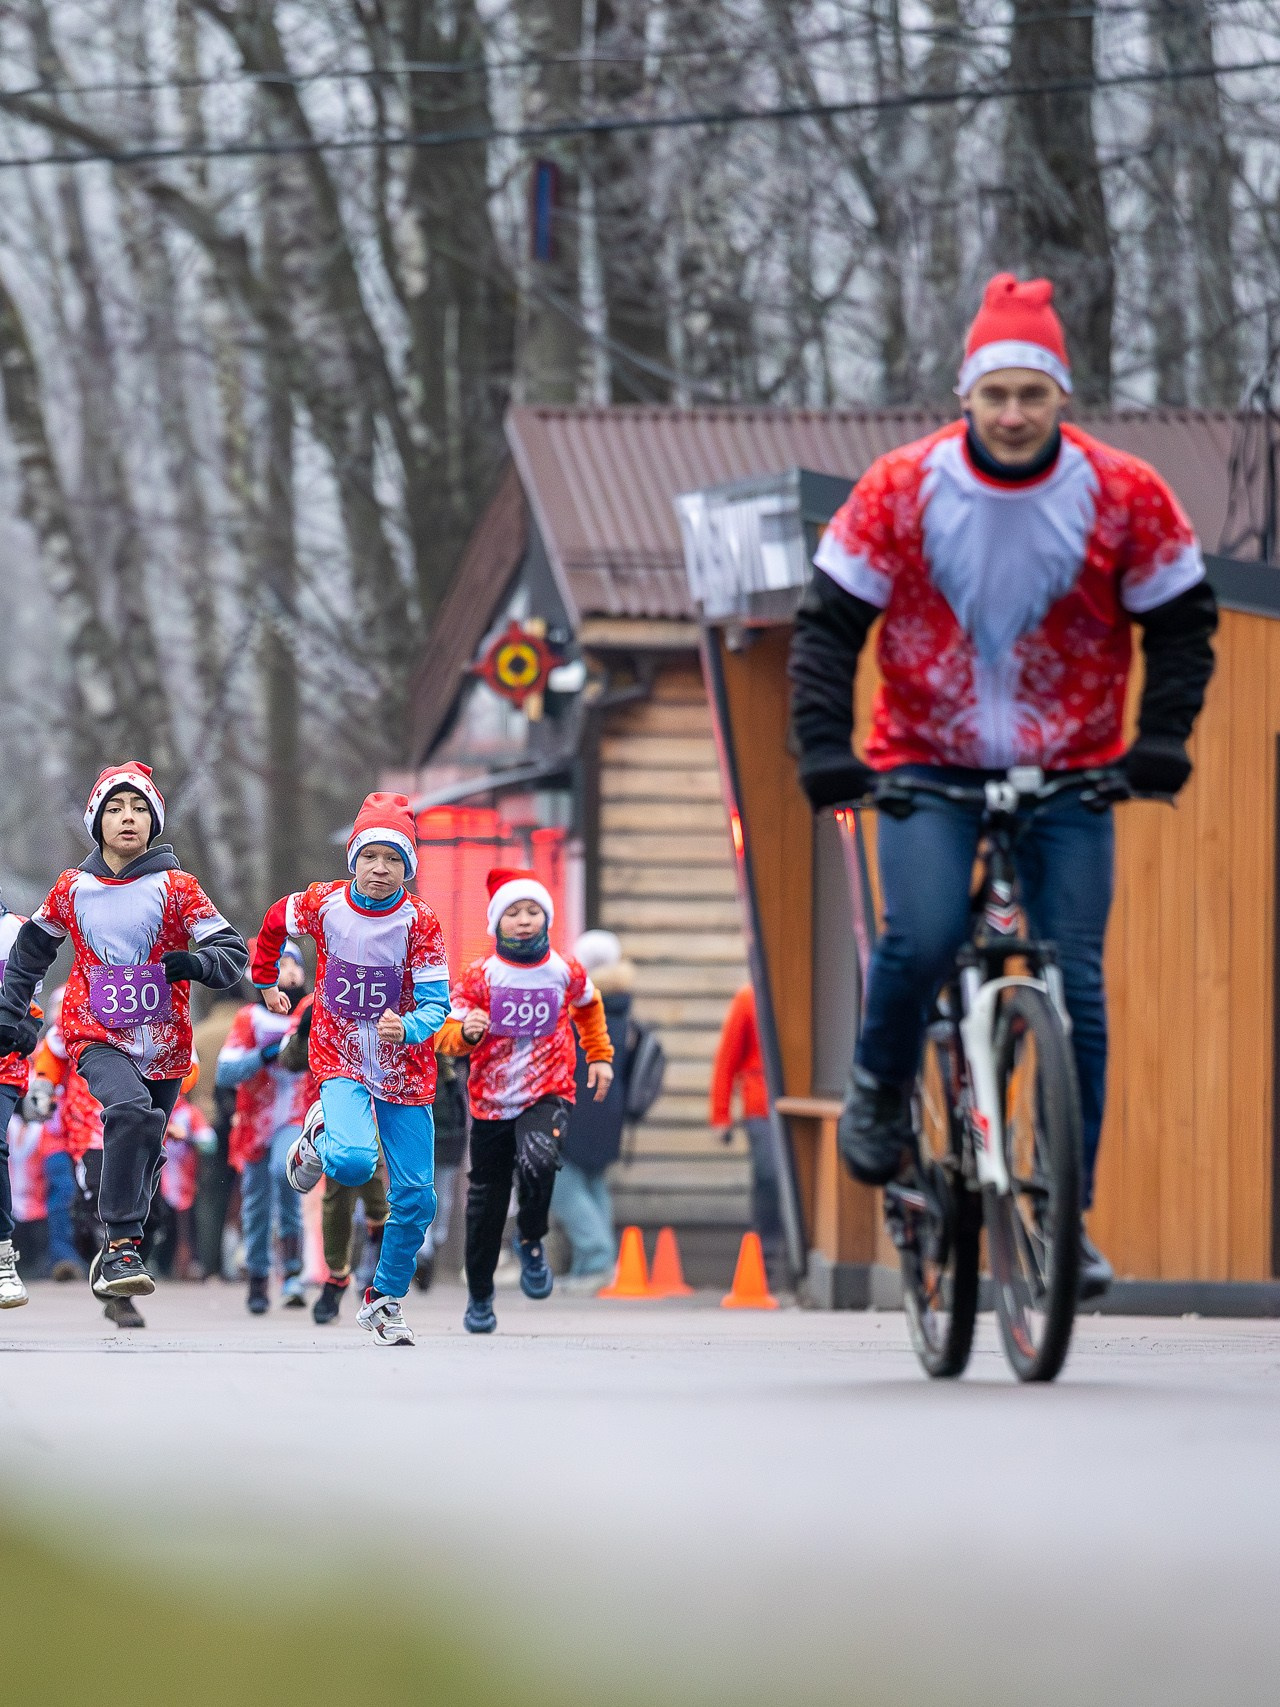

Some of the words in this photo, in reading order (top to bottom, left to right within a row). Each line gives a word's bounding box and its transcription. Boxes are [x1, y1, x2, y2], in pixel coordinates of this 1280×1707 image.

[101, 983, 160, 1014] 330
[334, 977, 387, 1008] 215
[501, 1000, 550, 1027] 299
